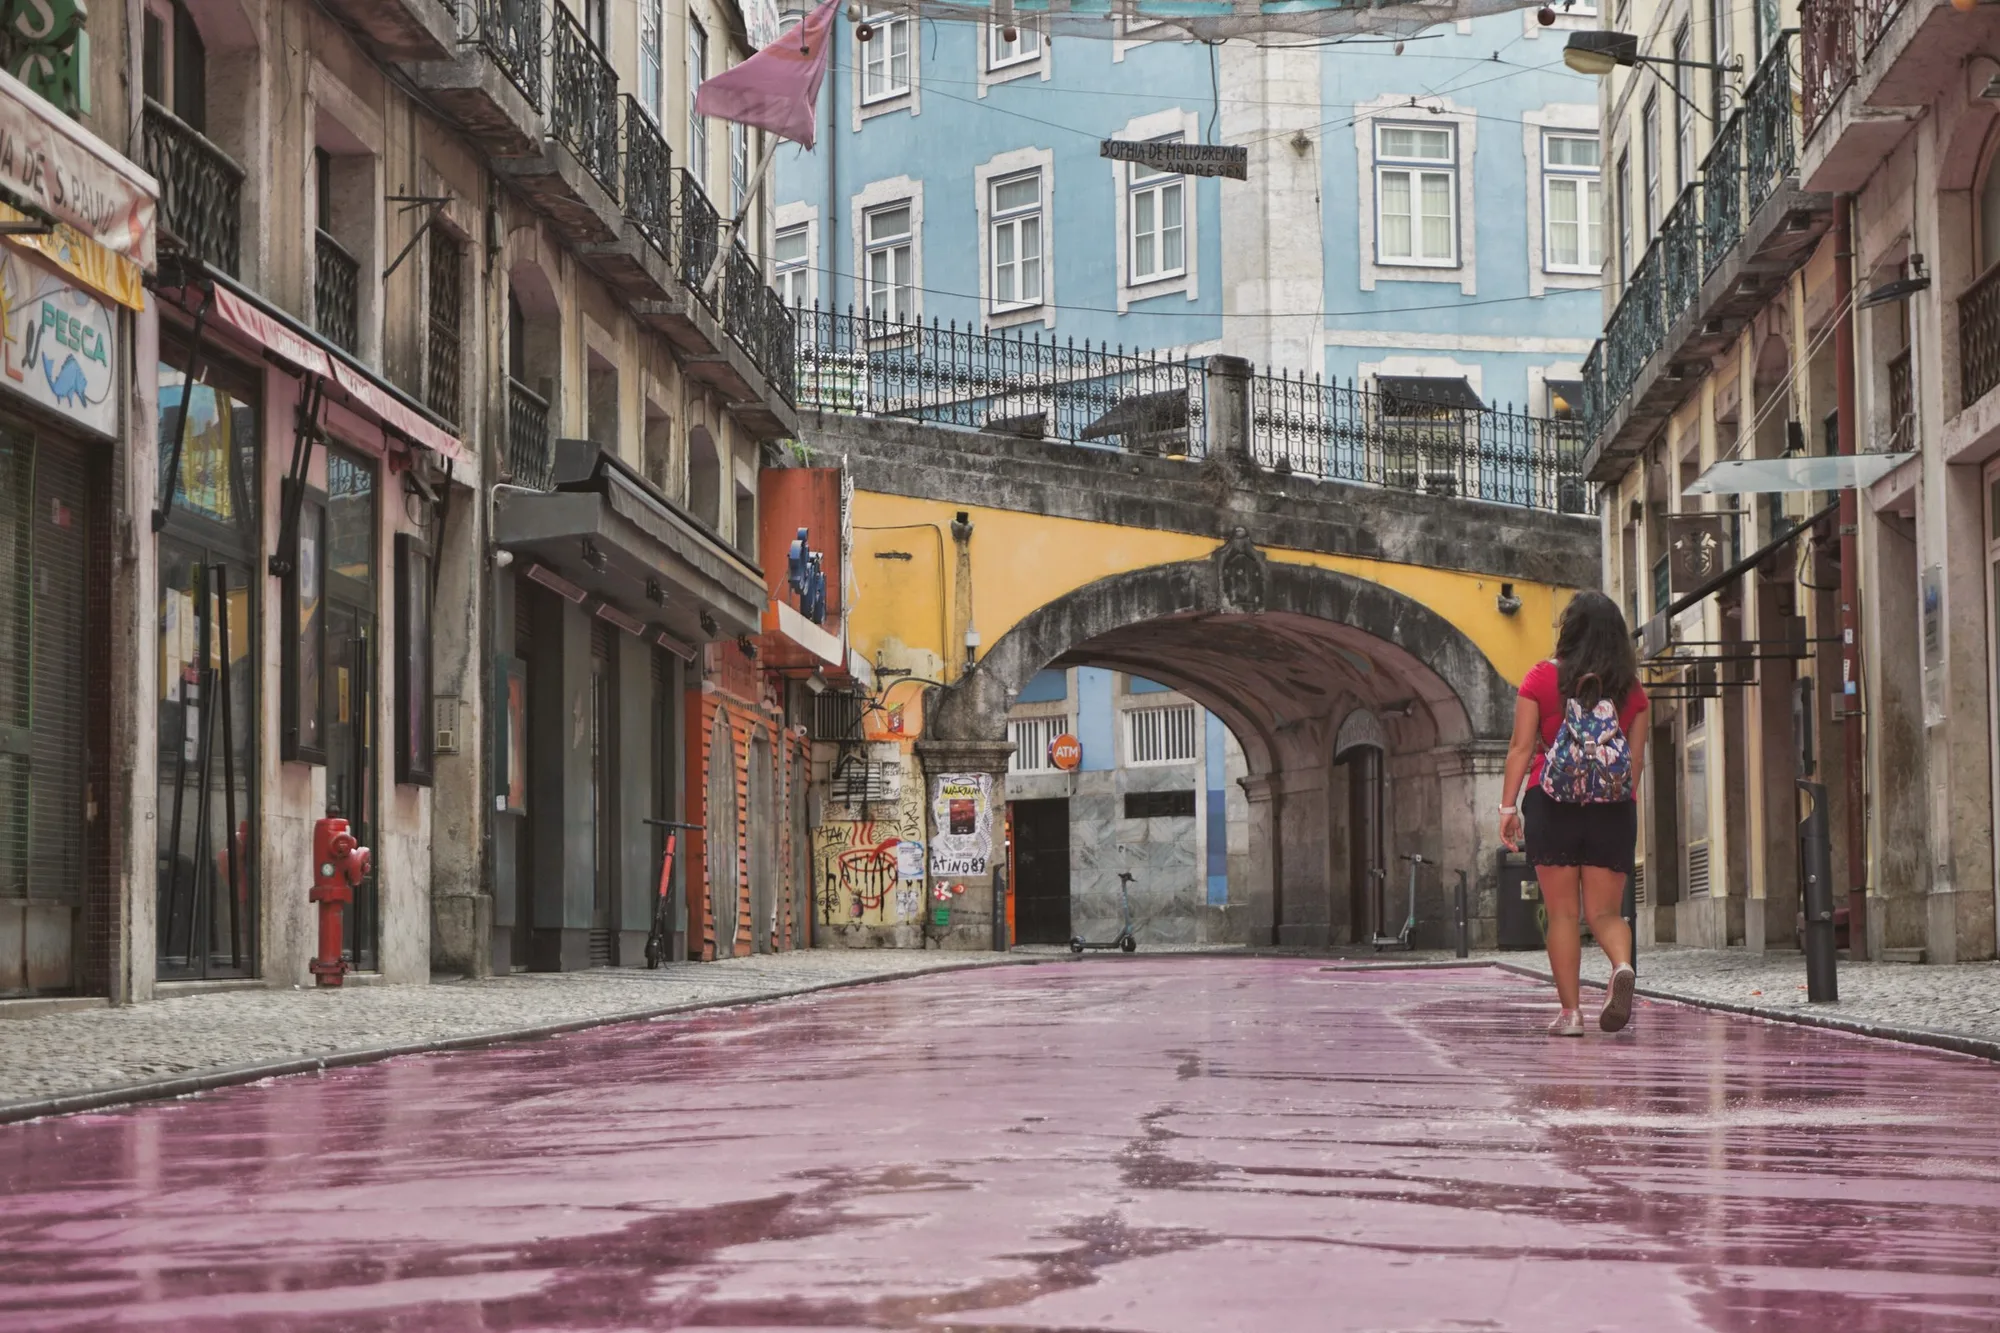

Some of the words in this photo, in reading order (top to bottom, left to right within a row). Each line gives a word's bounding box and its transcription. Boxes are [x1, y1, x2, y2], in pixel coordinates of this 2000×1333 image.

[1100, 140, 1145, 159] SOPHIA
[1148, 142, 1163, 161] DE
[1166, 142, 1200, 161] MELLO
[1201, 144, 1248, 162] BREYNER
[22, 145, 45, 195] DE
[53, 164, 67, 208] S.
[71, 173, 115, 236] PAULO
[42, 300, 107, 368] PESCA
[1055, 745, 1079, 759] ATM
